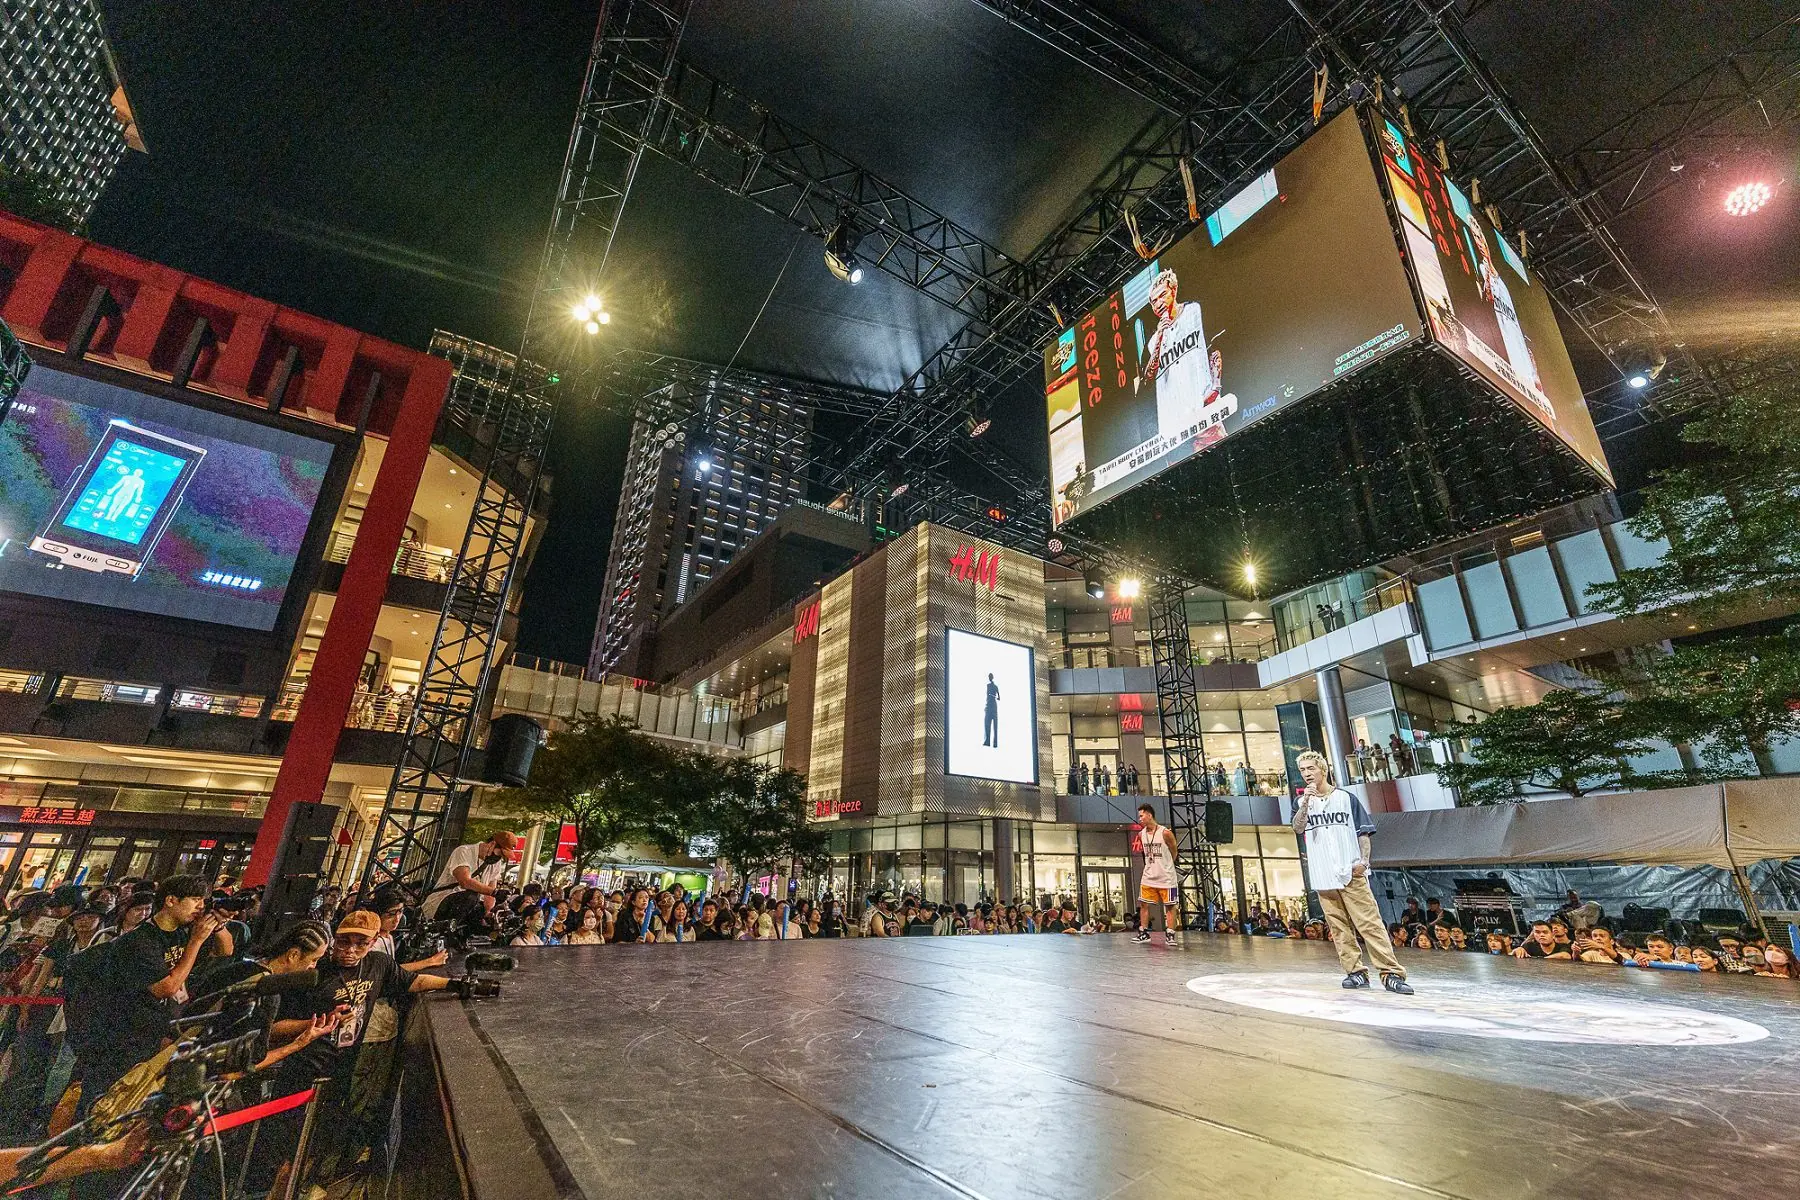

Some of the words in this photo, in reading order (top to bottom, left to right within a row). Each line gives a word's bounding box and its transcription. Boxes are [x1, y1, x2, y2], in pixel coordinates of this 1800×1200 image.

[1409, 143, 1451, 256] reeze
[1432, 165, 1471, 275] reeze
[1081, 313, 1103, 408] reeze
[1109, 291, 1127, 388] reeze
[1159, 330, 1200, 371] mway
[1241, 395, 1277, 421] Amway
[948, 543, 1000, 592] H&M
[794, 600, 820, 644] H&M
[1112, 606, 1133, 621] H&M
[1121, 714, 1143, 730] H&M
[20, 806, 96, 822] 新光三越
[832, 800, 862, 814] Breeze
